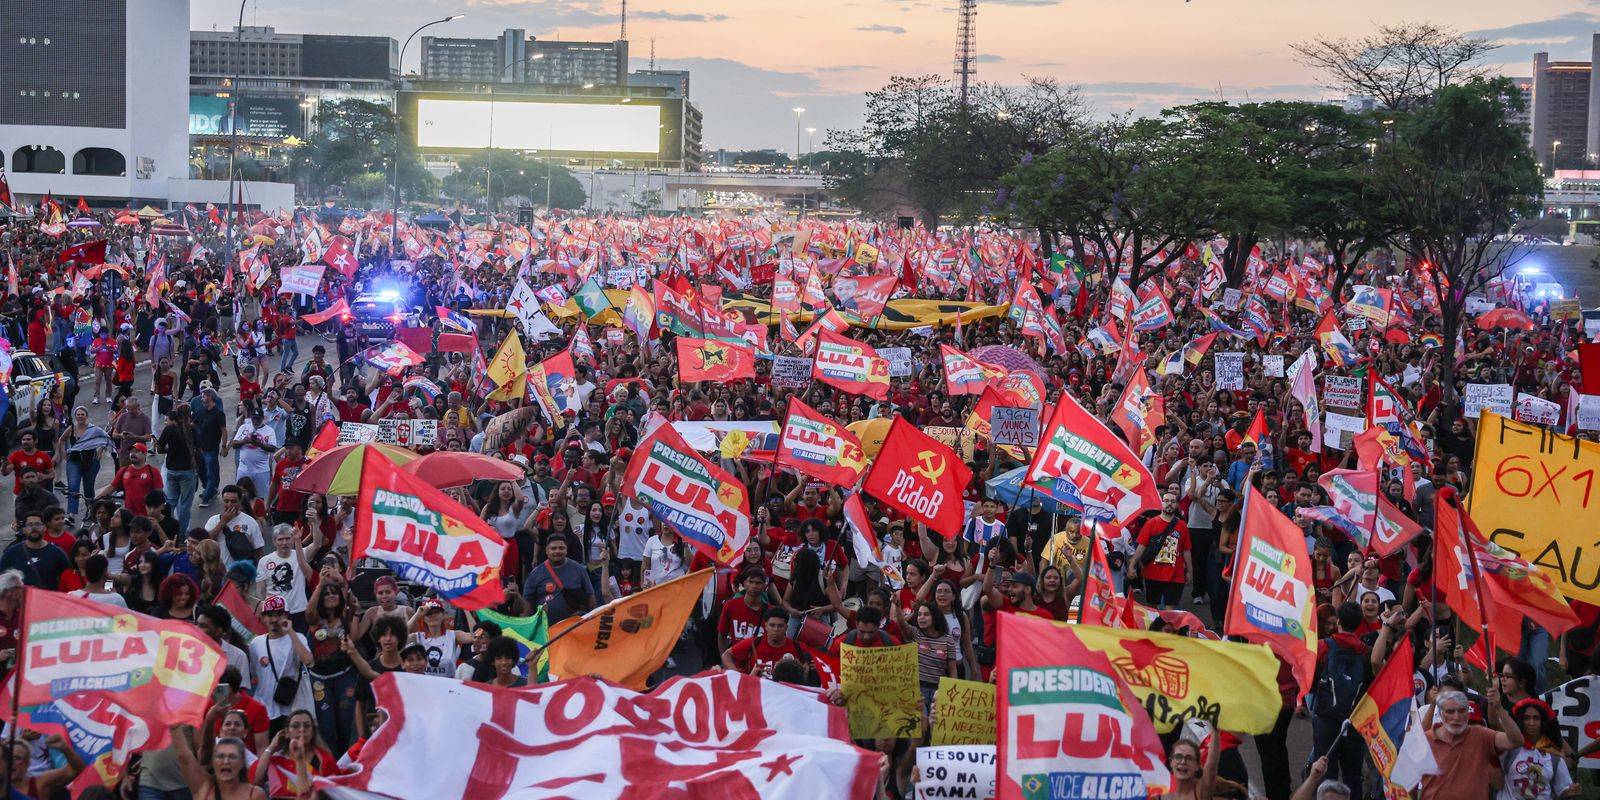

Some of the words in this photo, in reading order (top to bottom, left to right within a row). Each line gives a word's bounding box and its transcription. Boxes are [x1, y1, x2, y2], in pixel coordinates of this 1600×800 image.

[817, 351, 865, 368] LULA
[871, 359, 888, 376] 13
[997, 409, 1031, 422] 1964
[1001, 420, 1030, 431] NUNCA
[786, 426, 836, 449] LULA
[994, 431, 1034, 443] MAIS
[842, 444, 864, 463] 13
[1056, 479, 1074, 495] VICE
[1496, 455, 1594, 509] 6X1
[641, 462, 738, 539] LULA
[887, 468, 944, 520] PCdoB
[373, 519, 490, 570] LULA
[1245, 561, 1296, 608] LULA
[29, 617, 110, 636] PRESIDENTE
[30, 636, 148, 669] LULA
[163, 636, 206, 675] 13
[70, 673, 130, 691] ALCKMIN
[1012, 667, 1118, 698] PRESIDENT
[957, 772, 978, 784] NA
[1051, 774, 1080, 800] VICE
[1080, 773, 1147, 800] ALCKM
